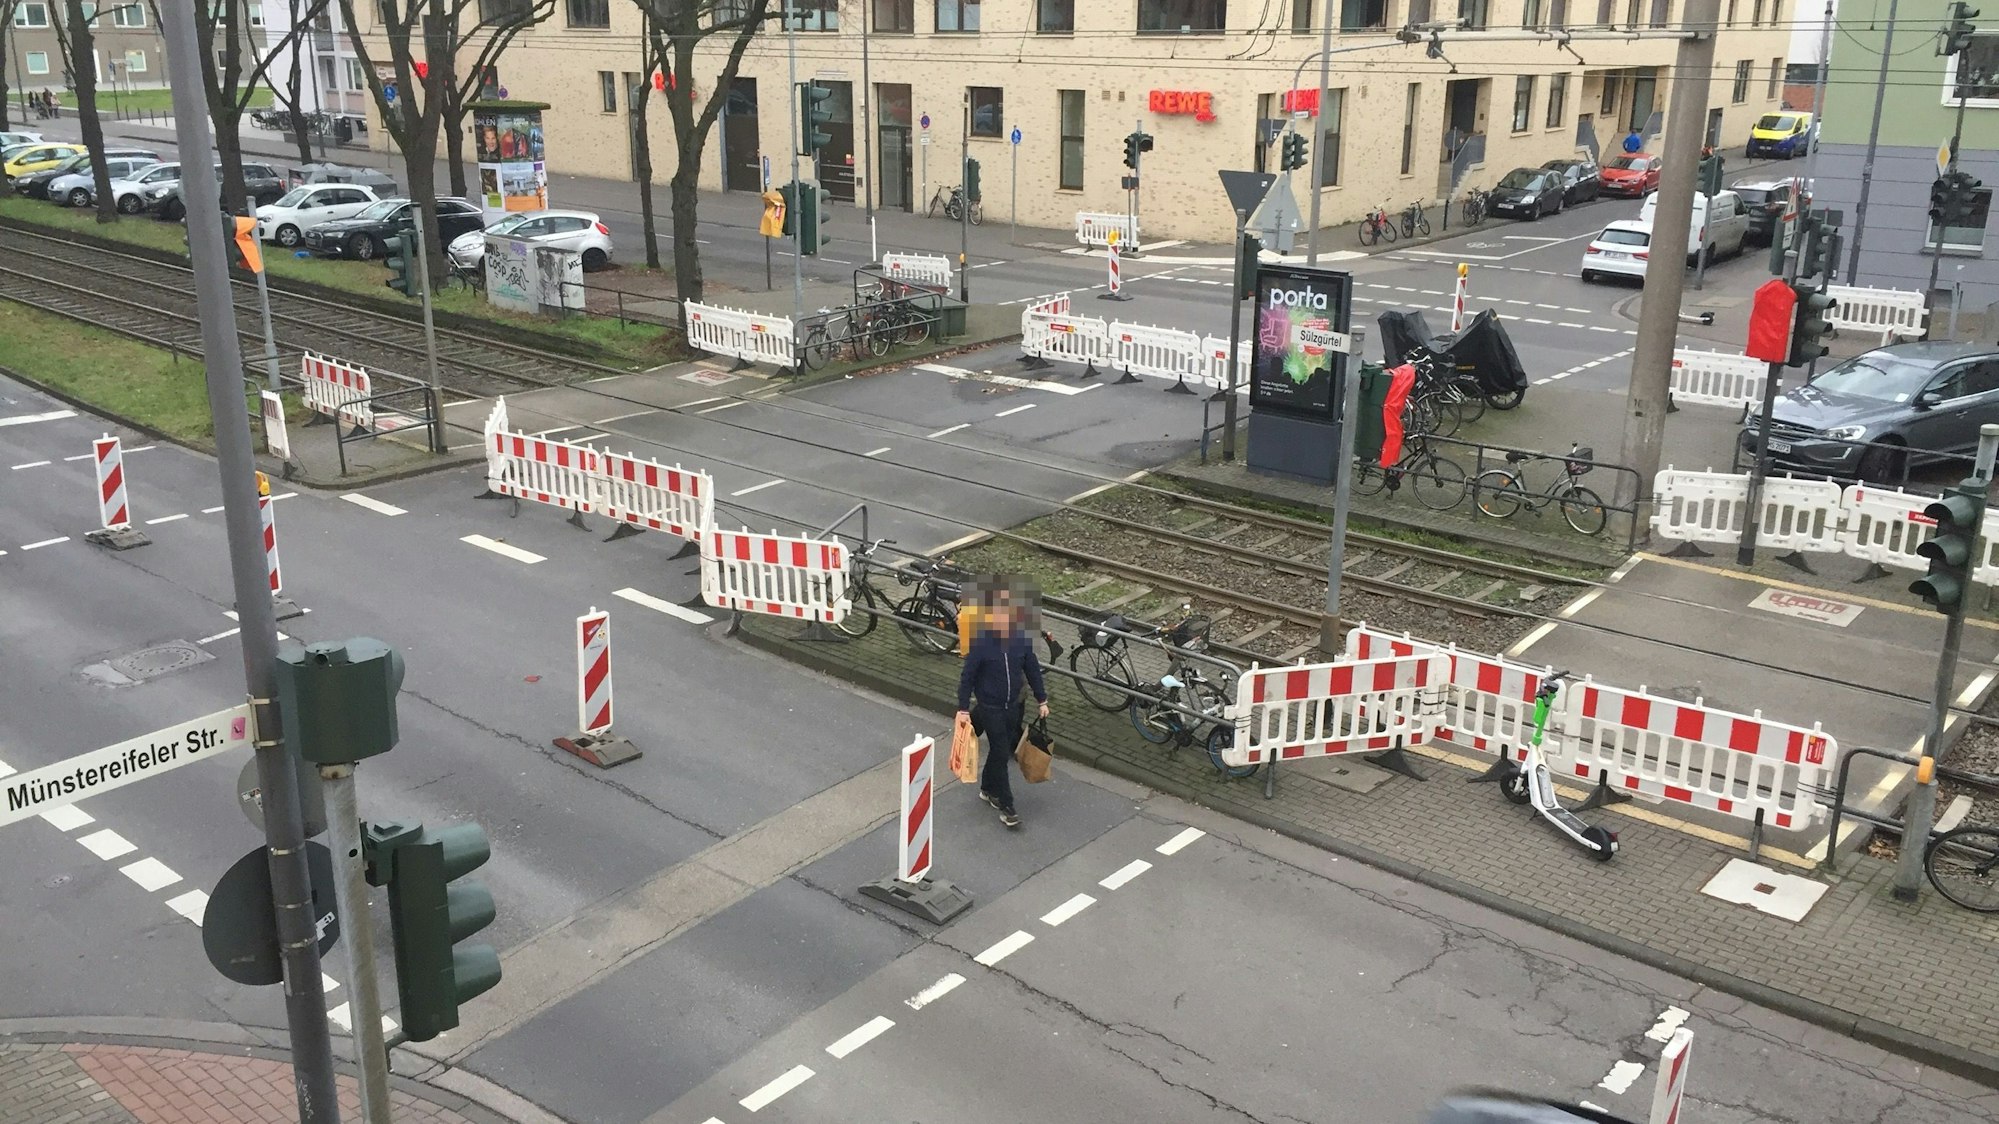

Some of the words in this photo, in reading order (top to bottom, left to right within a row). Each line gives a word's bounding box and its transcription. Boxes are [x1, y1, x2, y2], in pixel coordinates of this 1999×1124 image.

[1149, 90, 1213, 113] REWE
[1270, 285, 1327, 310] porta
[1300, 330, 1342, 347] Sülzgürtel
[7, 740, 180, 811] Münstereifeler
[186, 727, 225, 754] Str.
